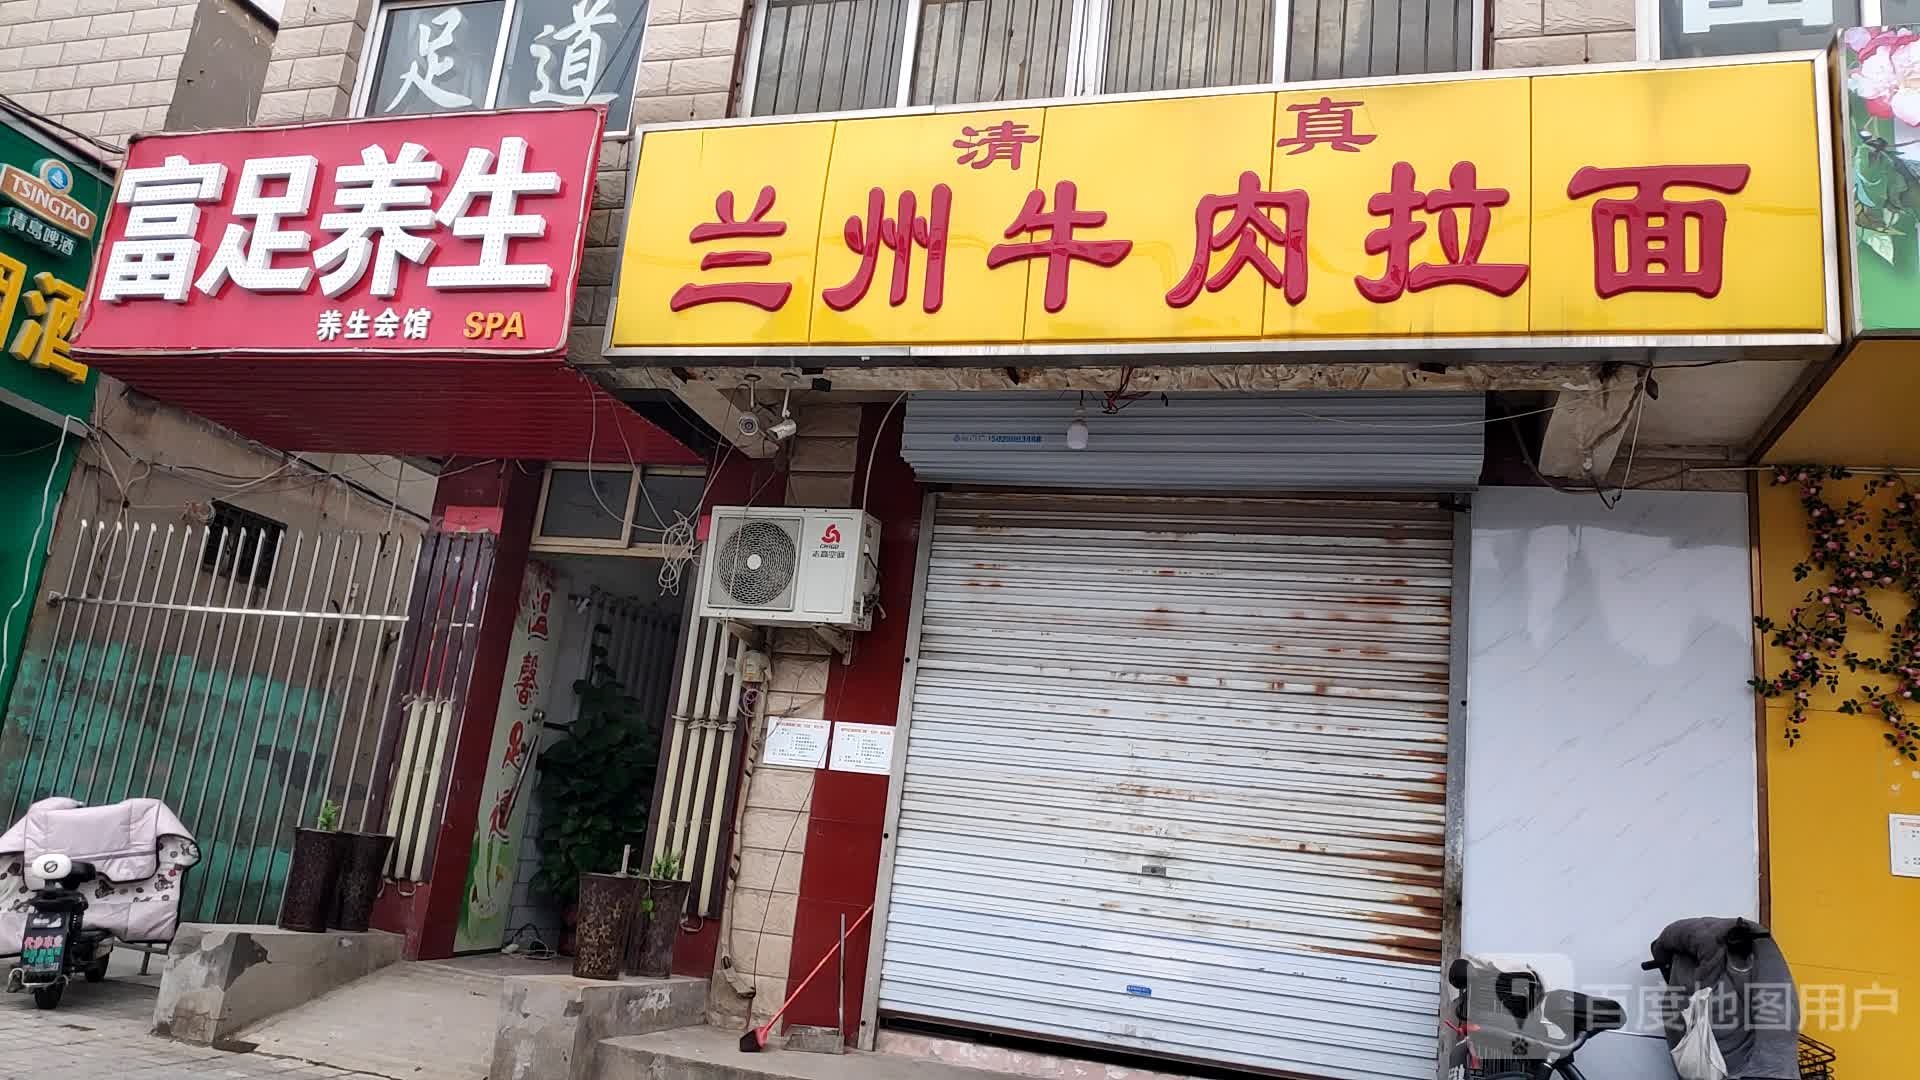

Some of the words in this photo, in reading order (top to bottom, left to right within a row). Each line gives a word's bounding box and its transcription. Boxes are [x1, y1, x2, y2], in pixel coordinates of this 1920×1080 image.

[385, 0, 619, 108] 足道
[11, 173, 90, 229] TSINGTAO
[100, 136, 561, 303] 富足养生
[670, 161, 1751, 314] 兰州牛肉拉面
[317, 308, 432, 343] 养生会馆
[463, 312, 526, 339] SPA
